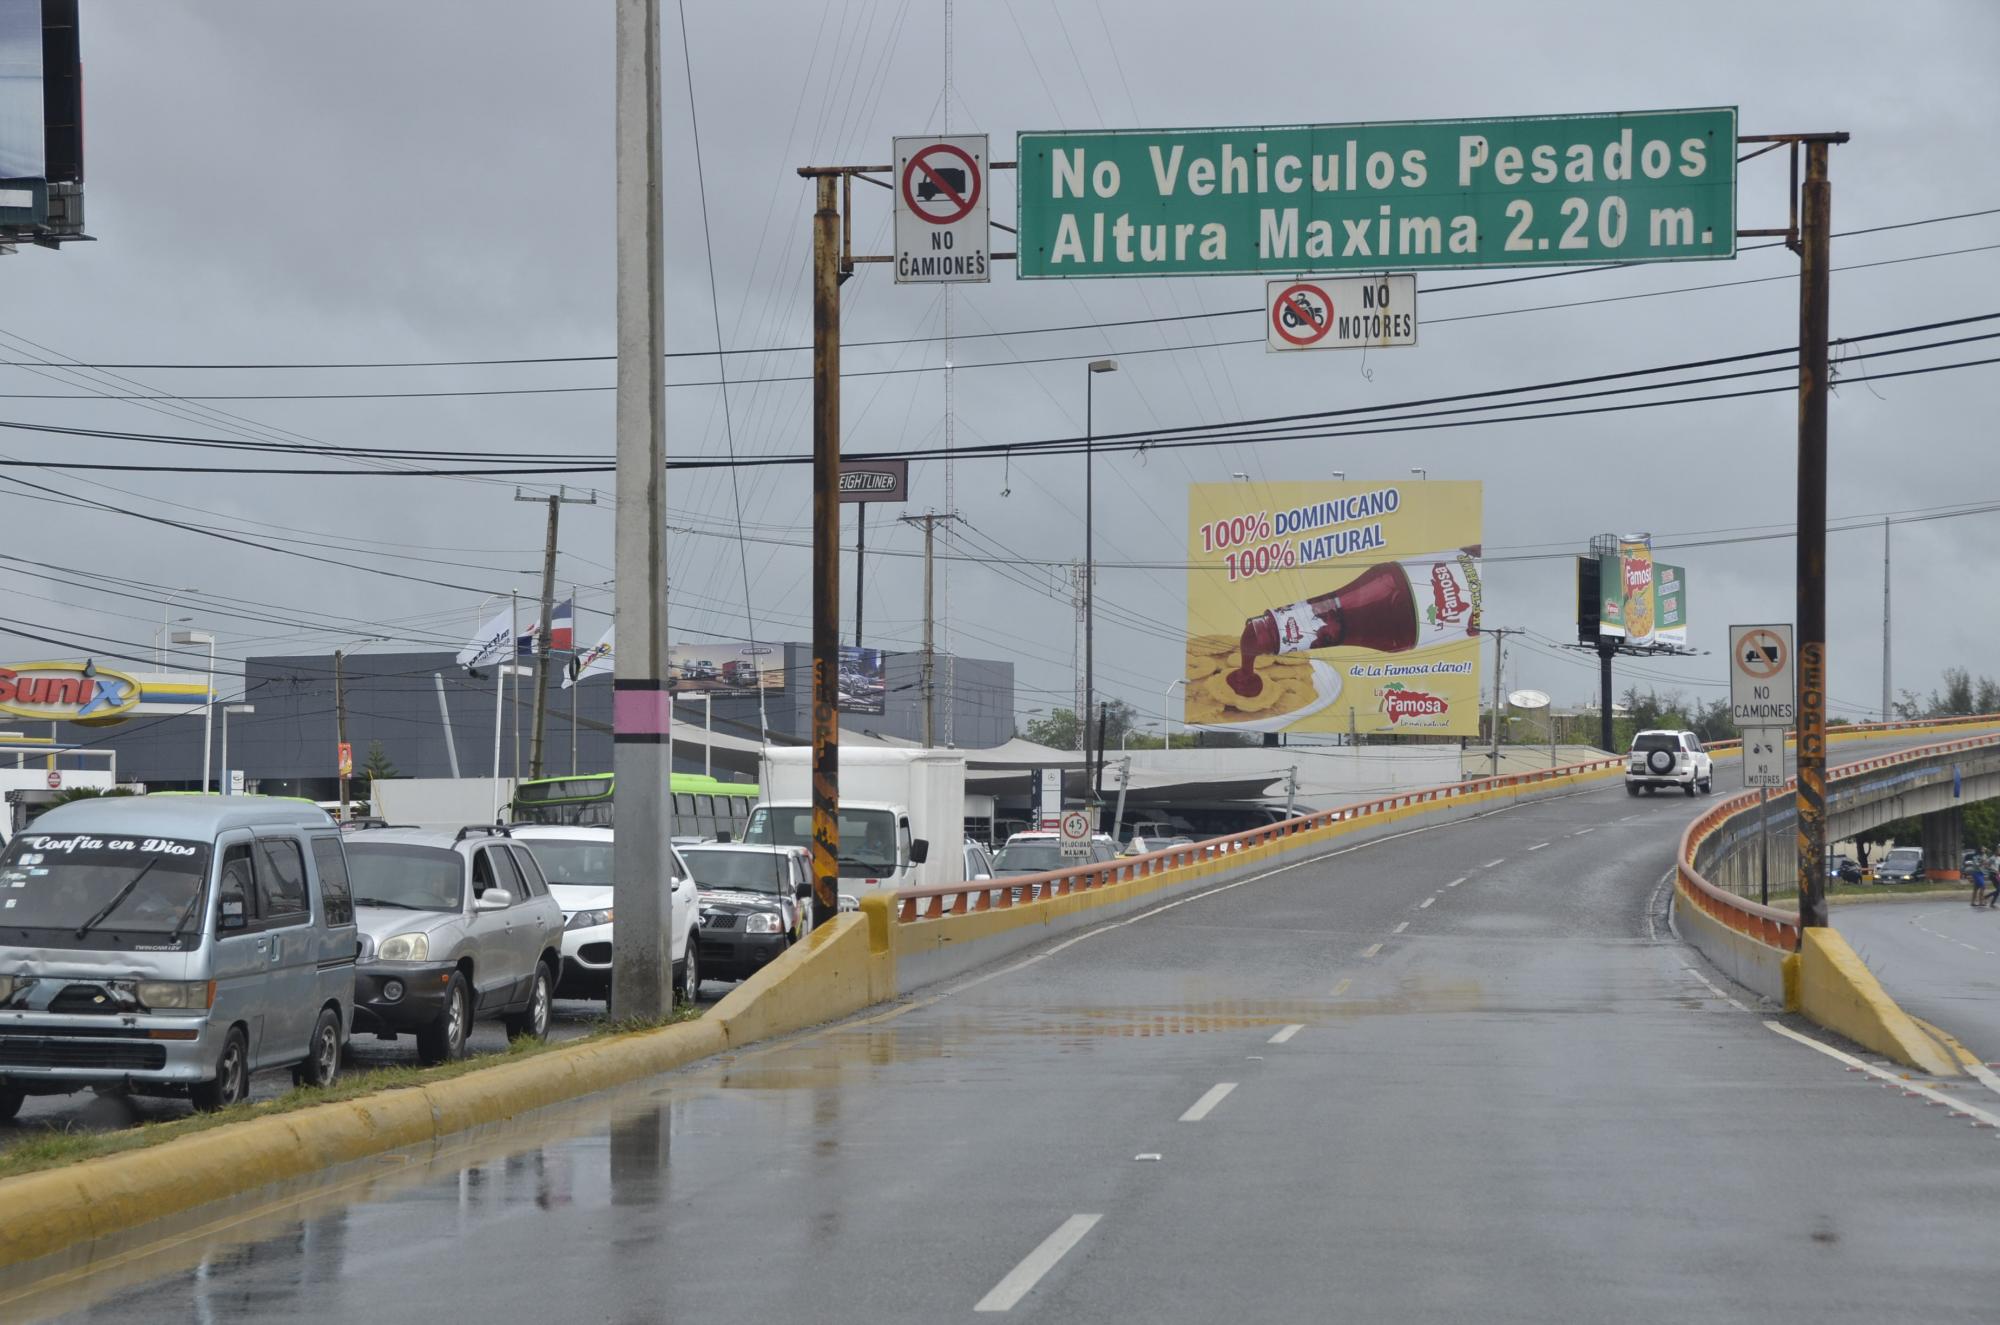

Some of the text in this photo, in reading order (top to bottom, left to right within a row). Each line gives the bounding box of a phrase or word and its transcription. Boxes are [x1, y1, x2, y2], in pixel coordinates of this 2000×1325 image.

[1050, 127, 1708, 199] No Vehiculos Pesados
[1050, 194, 1714, 264] Altura Maxima 2.20 m.
[931, 230, 954, 250] NO
[899, 255, 986, 277] CAMIONES
[1362, 284, 1390, 309] NO
[1338, 313, 1411, 340] MOTORES
[838, 473, 894, 490] EIGHTLINER
[1200, 489, 1399, 552] 100% DOMINICANO
[1225, 524, 1385, 581] 100% NATURAL
[1435, 566, 1459, 618] Famosa
[1350, 664, 1363, 676] de
[1367, 664, 1381, 677] La
[1384, 664, 1428, 676] Famosa
[1373, 687, 1384, 697] La
[1754, 685, 1770, 700] NO
[1388, 694, 1441, 713] Famosa
[1734, 704, 1793, 718] CAMIONES
[1758, 765, 1768, 774] NO
[1748, 775, 1780, 785] MOTORES
[1069, 819, 1082, 830] 45
[108, 839, 136, 851] en
[140, 839, 197, 856] Dios
